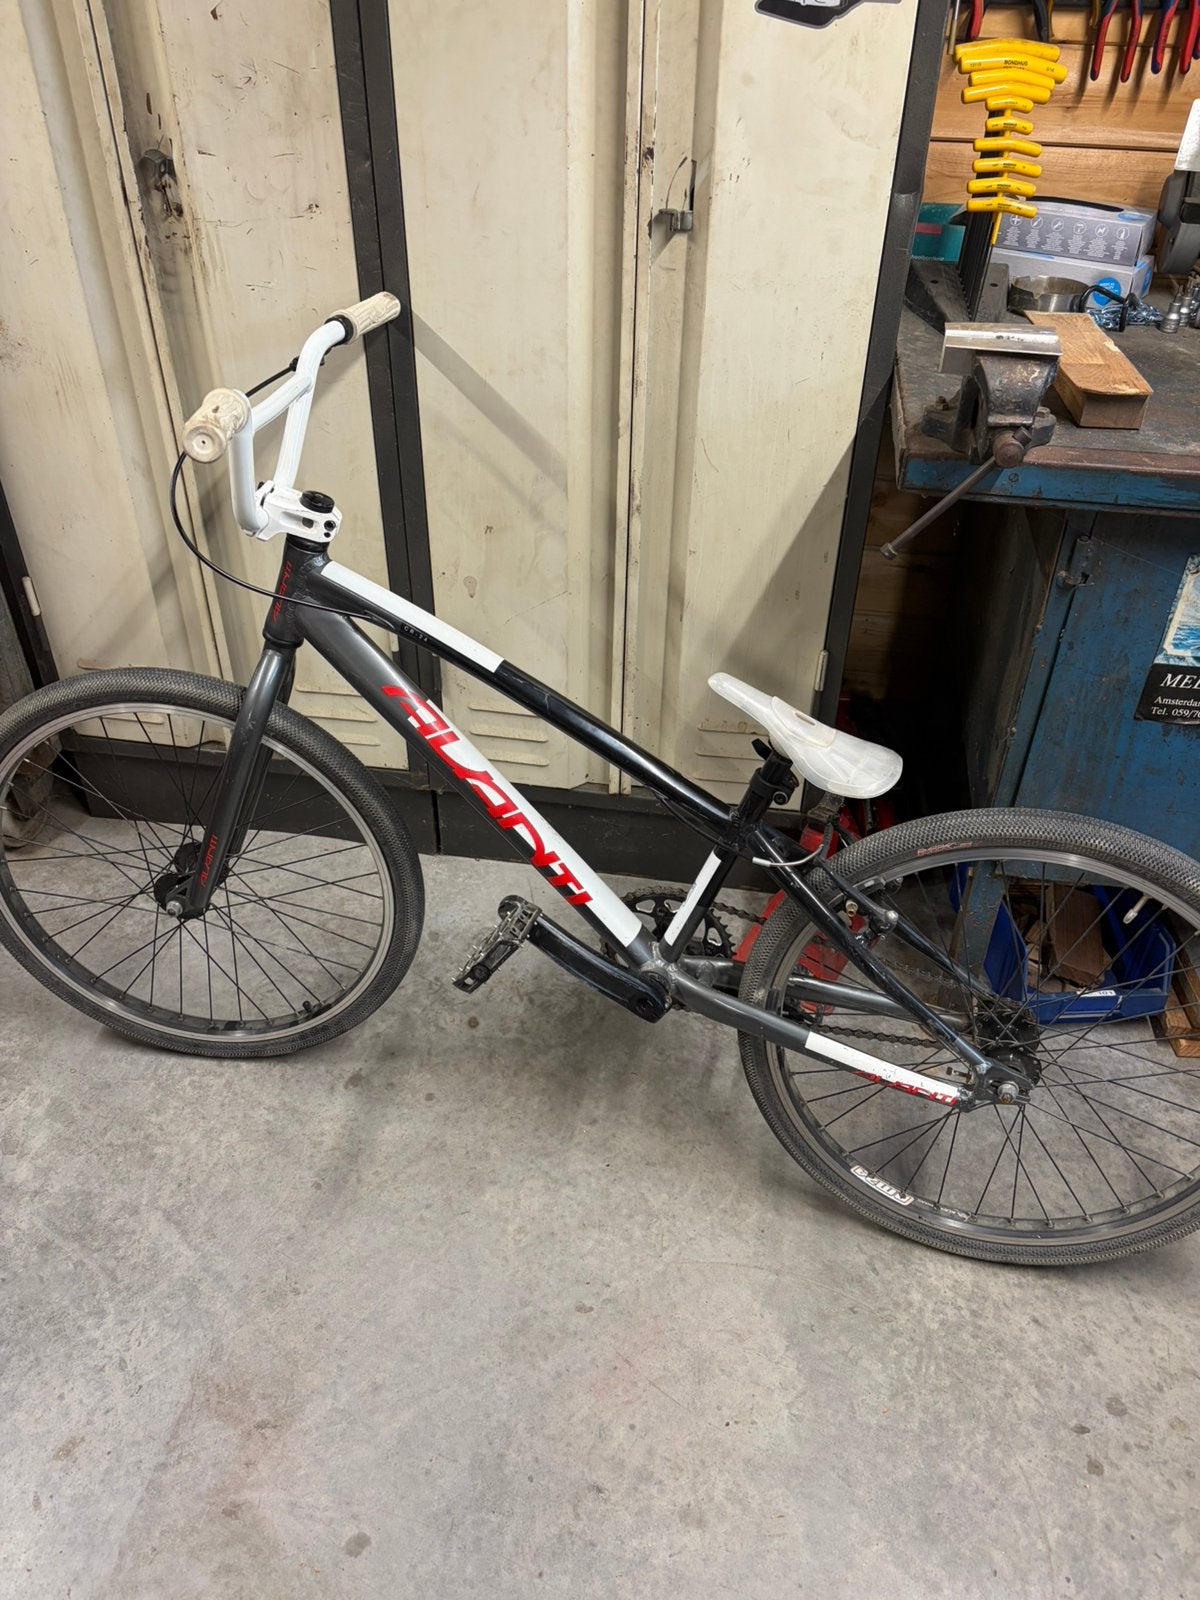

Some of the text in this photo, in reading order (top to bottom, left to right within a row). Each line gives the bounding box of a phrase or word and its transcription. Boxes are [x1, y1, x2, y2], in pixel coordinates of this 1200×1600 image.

[1154, 696, 1200, 707] Amsterda
[1151, 706, 1168, 716] Tel.
[380, 685, 594, 905] AVANTI
